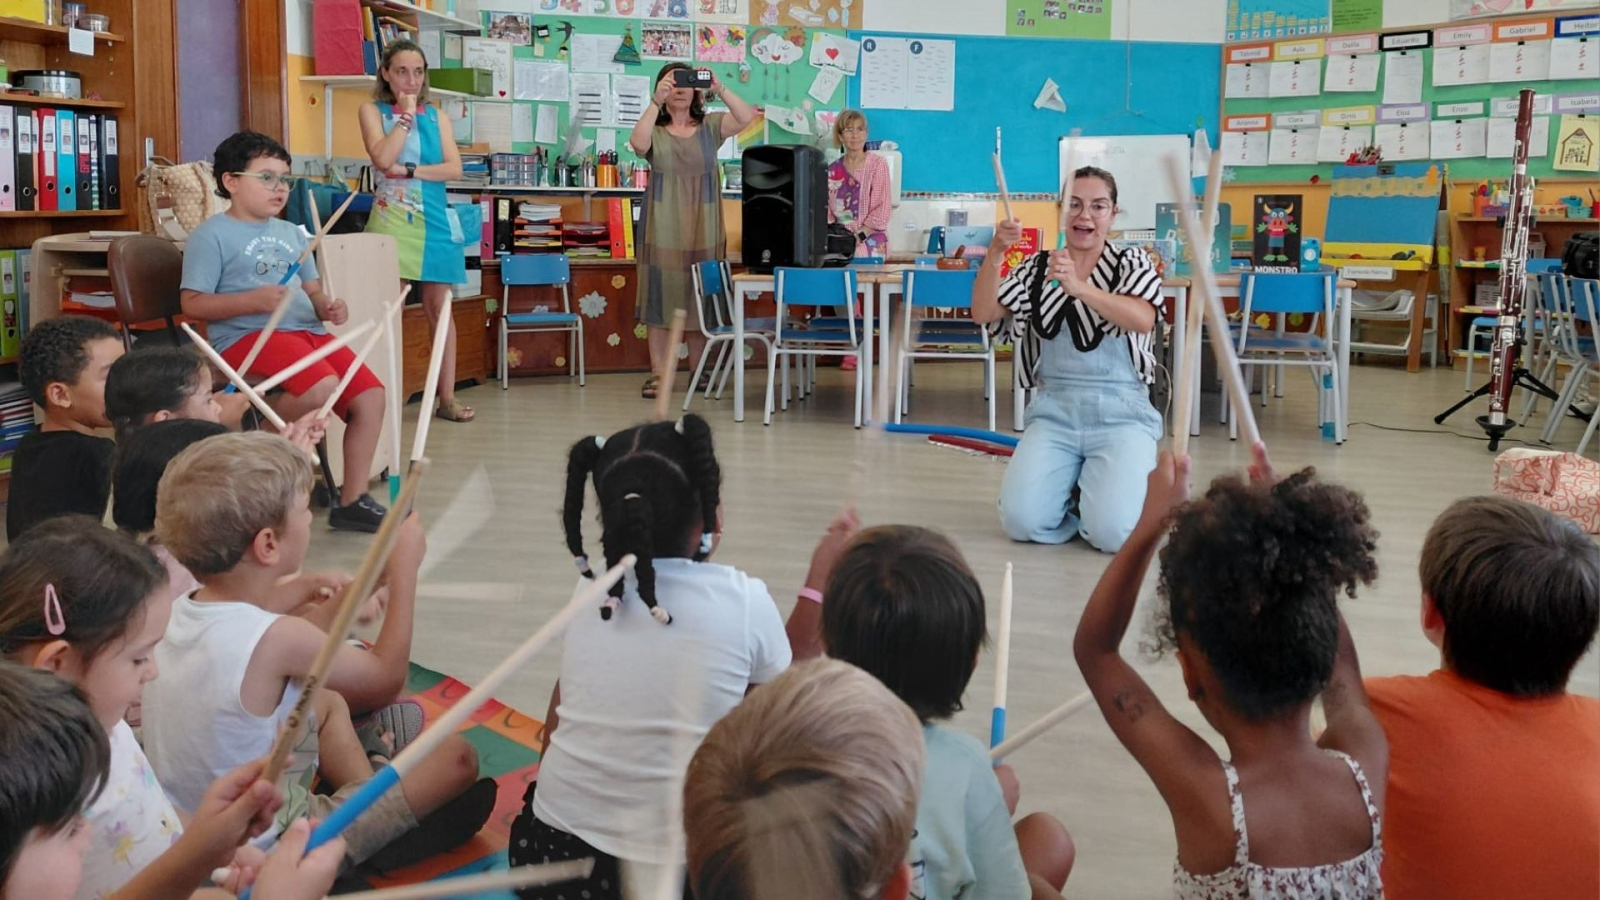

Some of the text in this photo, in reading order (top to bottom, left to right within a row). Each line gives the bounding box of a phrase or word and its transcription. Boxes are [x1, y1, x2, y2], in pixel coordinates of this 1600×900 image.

[1509, 26, 1536, 35] Gabriel
[1391, 36, 1420, 45] Eduardo
[866, 42, 873, 50] R
[914, 44, 920, 52] F
[1570, 98, 1598, 106] Isabela
[1254, 265, 1298, 274] MONSTRO
